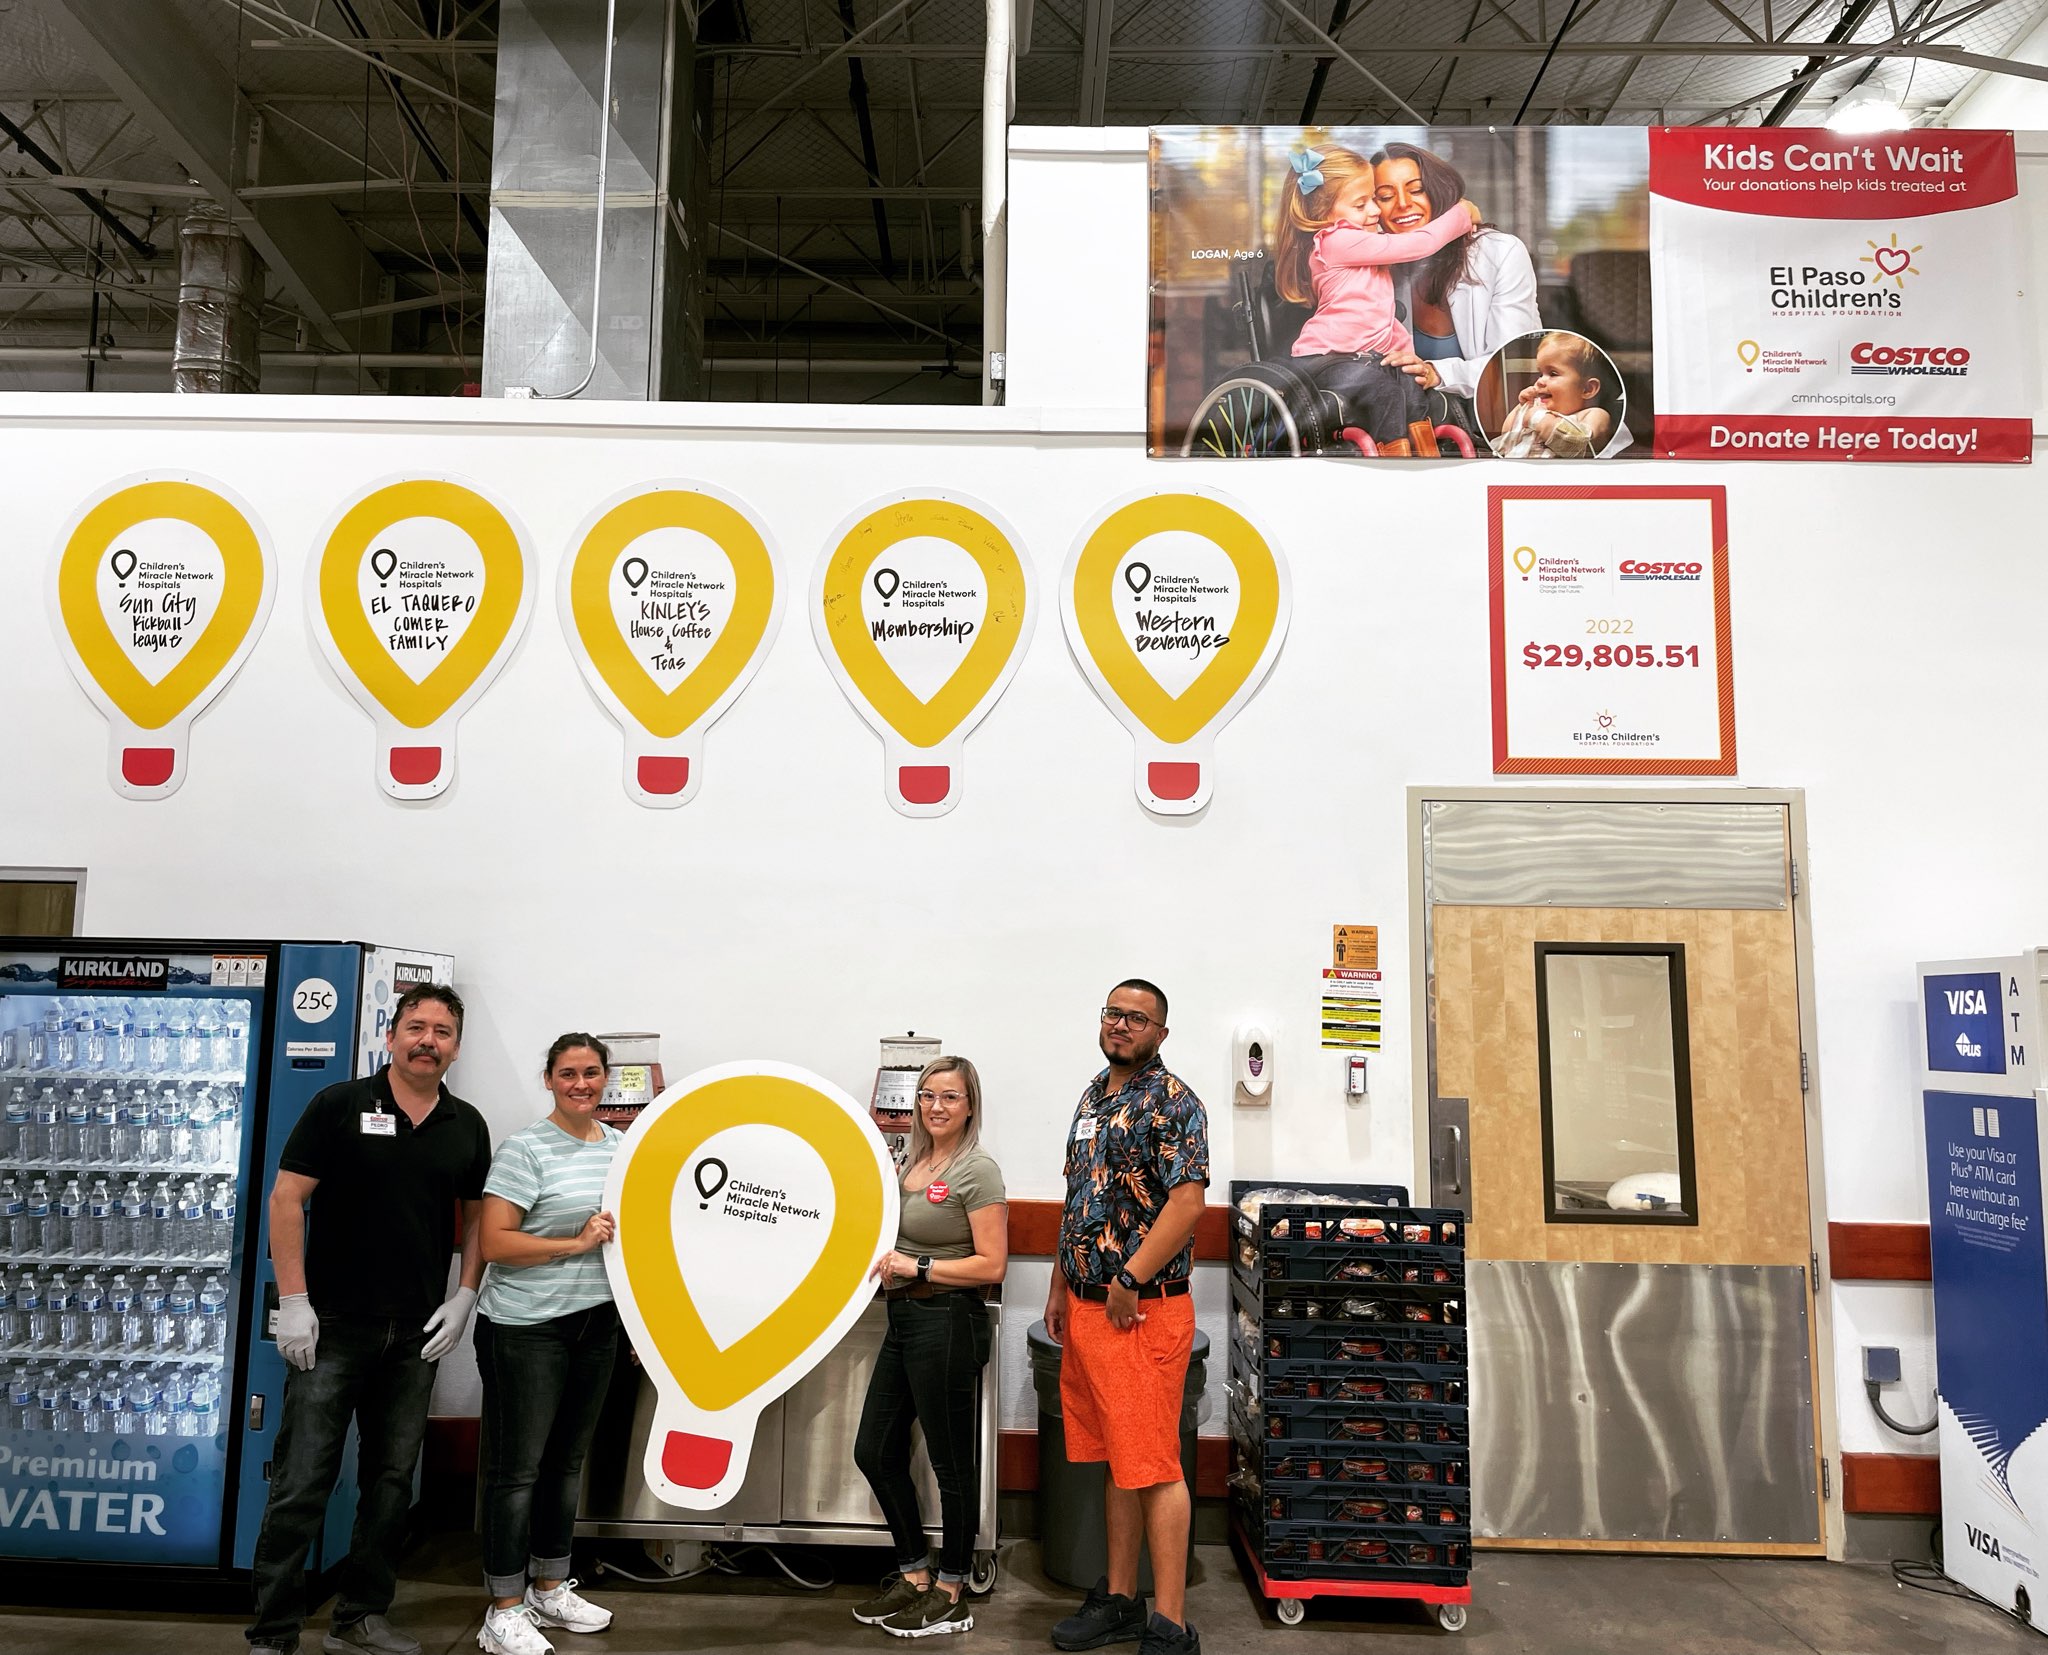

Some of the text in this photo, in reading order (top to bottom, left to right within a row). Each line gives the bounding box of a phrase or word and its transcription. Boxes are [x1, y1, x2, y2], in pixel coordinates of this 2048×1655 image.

[1705, 145, 1963, 173] Kids Can't Wait
[1703, 178, 1966, 193] Your donations help kids treated at
[1192, 250, 1263, 260] LOGAN, Age 6
[1771, 268, 1865, 285] El Paso
[1772, 289, 1901, 309] Children's
[1851, 343, 1970, 365] COSTCO
[1888, 367, 1967, 376] WHOLESALE
[1792, 393, 1896, 406] cmnhospitals.org
[1711, 425, 1977, 454] Donate Here Today!
[140, 562, 185, 570] Children's
[1619, 560, 1702, 574] COSTCO
[139, 572, 214, 580] Miracle Network
[651, 571, 696, 580] Children's
[1154, 576, 1199, 584] Children's
[1539, 574, 1577, 583] Hospitals
[138, 581, 180, 590] Hospitals
[400, 580, 442, 589] Hospitals
[650, 590, 692, 599] Hospitals
[902, 590, 976, 598] Miracle Network
[1154, 595, 1196, 604] Hospitals
[120, 593, 153, 613] Sun
[372, 594, 475, 614] EL TAQUERO
[902, 600, 944, 608] Hospitals
[394, 617, 448, 632] COMER
[631, 620, 711, 638] House Coffee
[1136, 610, 1214, 633] Western
[1586, 620, 1634, 634] 2022
[872, 617, 974, 643] Membership
[389, 634, 448, 650] FAMILY
[1135, 634, 1230, 660] Beverages
[651, 654, 686, 670] Teas
[1523, 642, 1699, 670] $29,805.51
[1612, 733, 1660, 741] Children's
[65, 961, 164, 977] KIRKLAND
[397, 966, 431, 983] KIRKLAND
[1341, 971, 1377, 979] WARNING
[297, 991, 332, 1010] 25¢
[1944, 990, 1987, 1015] VISA
[1948, 1142, 2016, 1164] Use your Visa or
[1975, 1166, 1994, 1182] ATM
[1996, 1171, 2016, 1185] card
[730, 1180, 786, 1199] Children's
[1950, 1181, 2019, 1207] here without an
[727, 1192, 820, 1220] Miracle Network
[724, 1205, 777, 1224] Hospitals
[1946, 1202, 1964, 1218] ATM
[1966, 1208, 2009, 1230] surcharge
[1964, 1522, 2001, 1562] VISA
